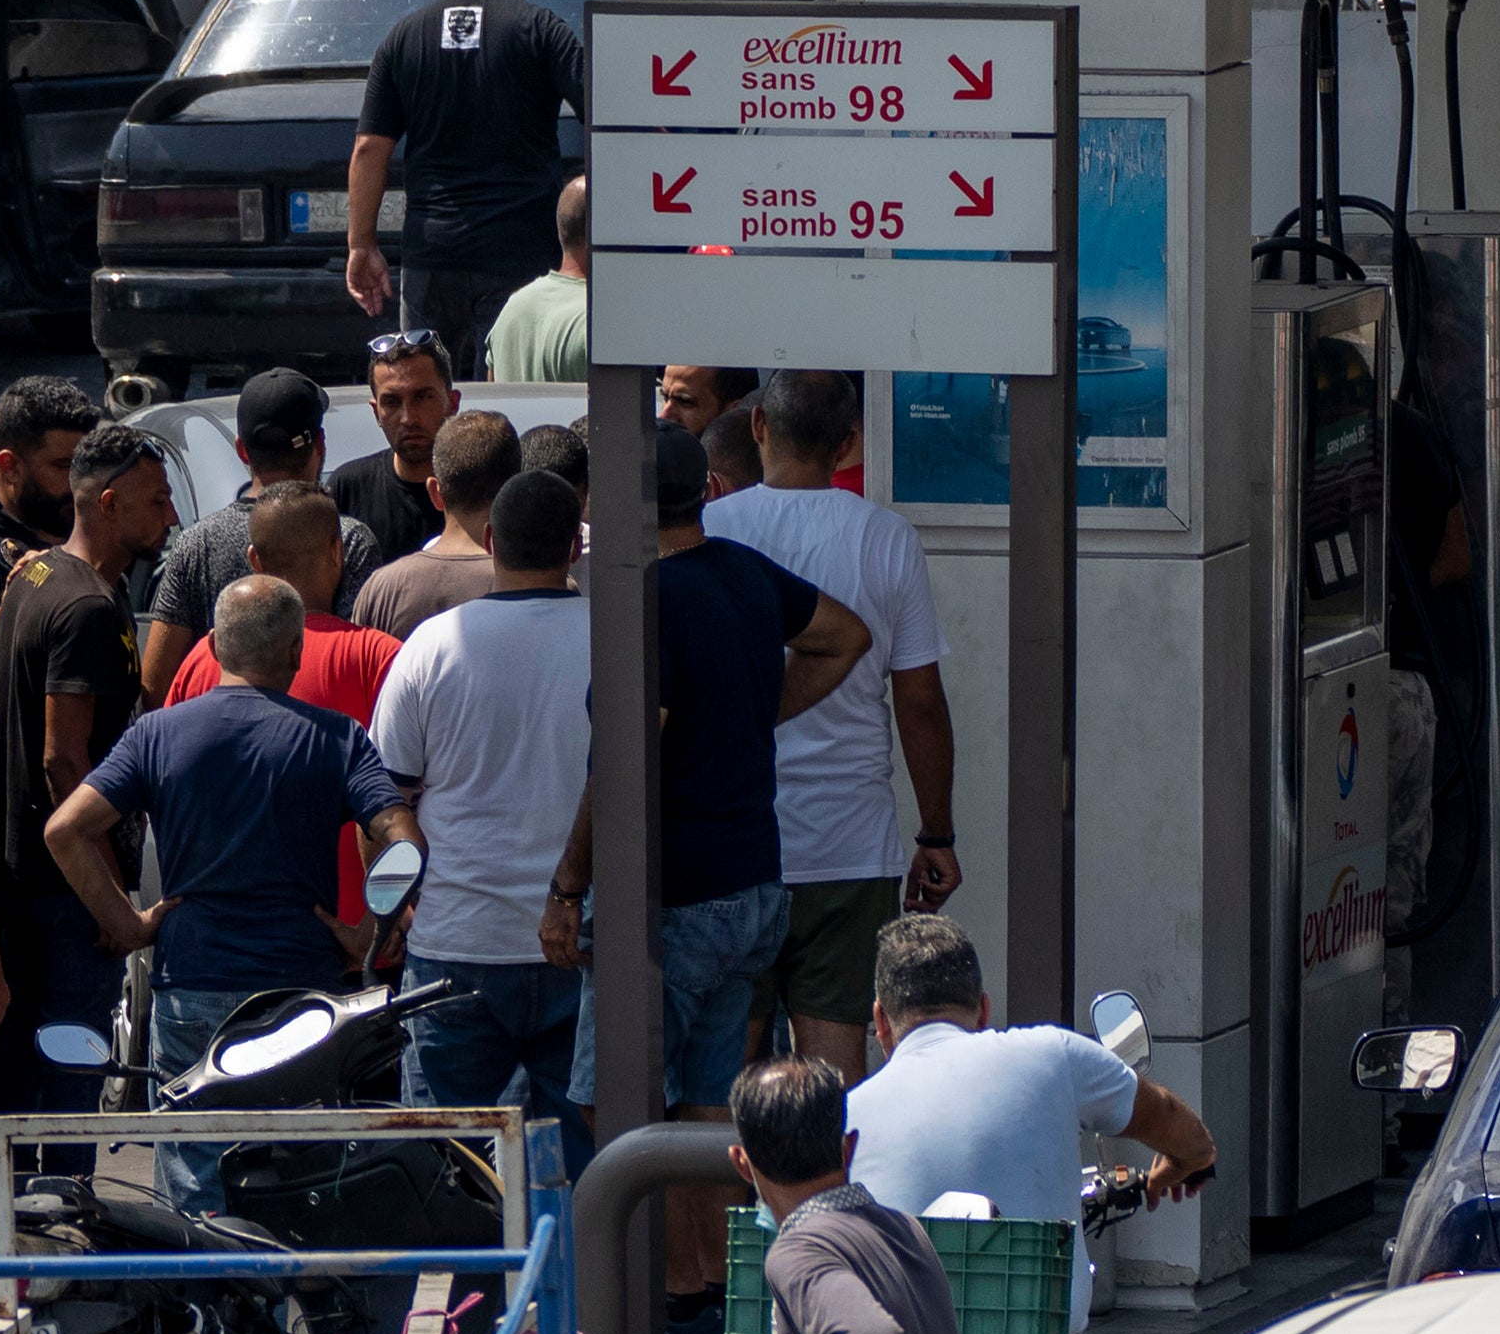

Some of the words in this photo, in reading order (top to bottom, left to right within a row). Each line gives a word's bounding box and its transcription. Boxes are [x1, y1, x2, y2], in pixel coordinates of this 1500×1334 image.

[743, 30, 903, 65] excellium
[741, 71, 816, 90] sans
[740, 95, 836, 124] plomb
[849, 85, 905, 123] 98
[742, 188, 818, 207] sans
[741, 212, 837, 242] plomb
[850, 200, 905, 240] 95
[1334, 821, 1358, 841] TOTAL
